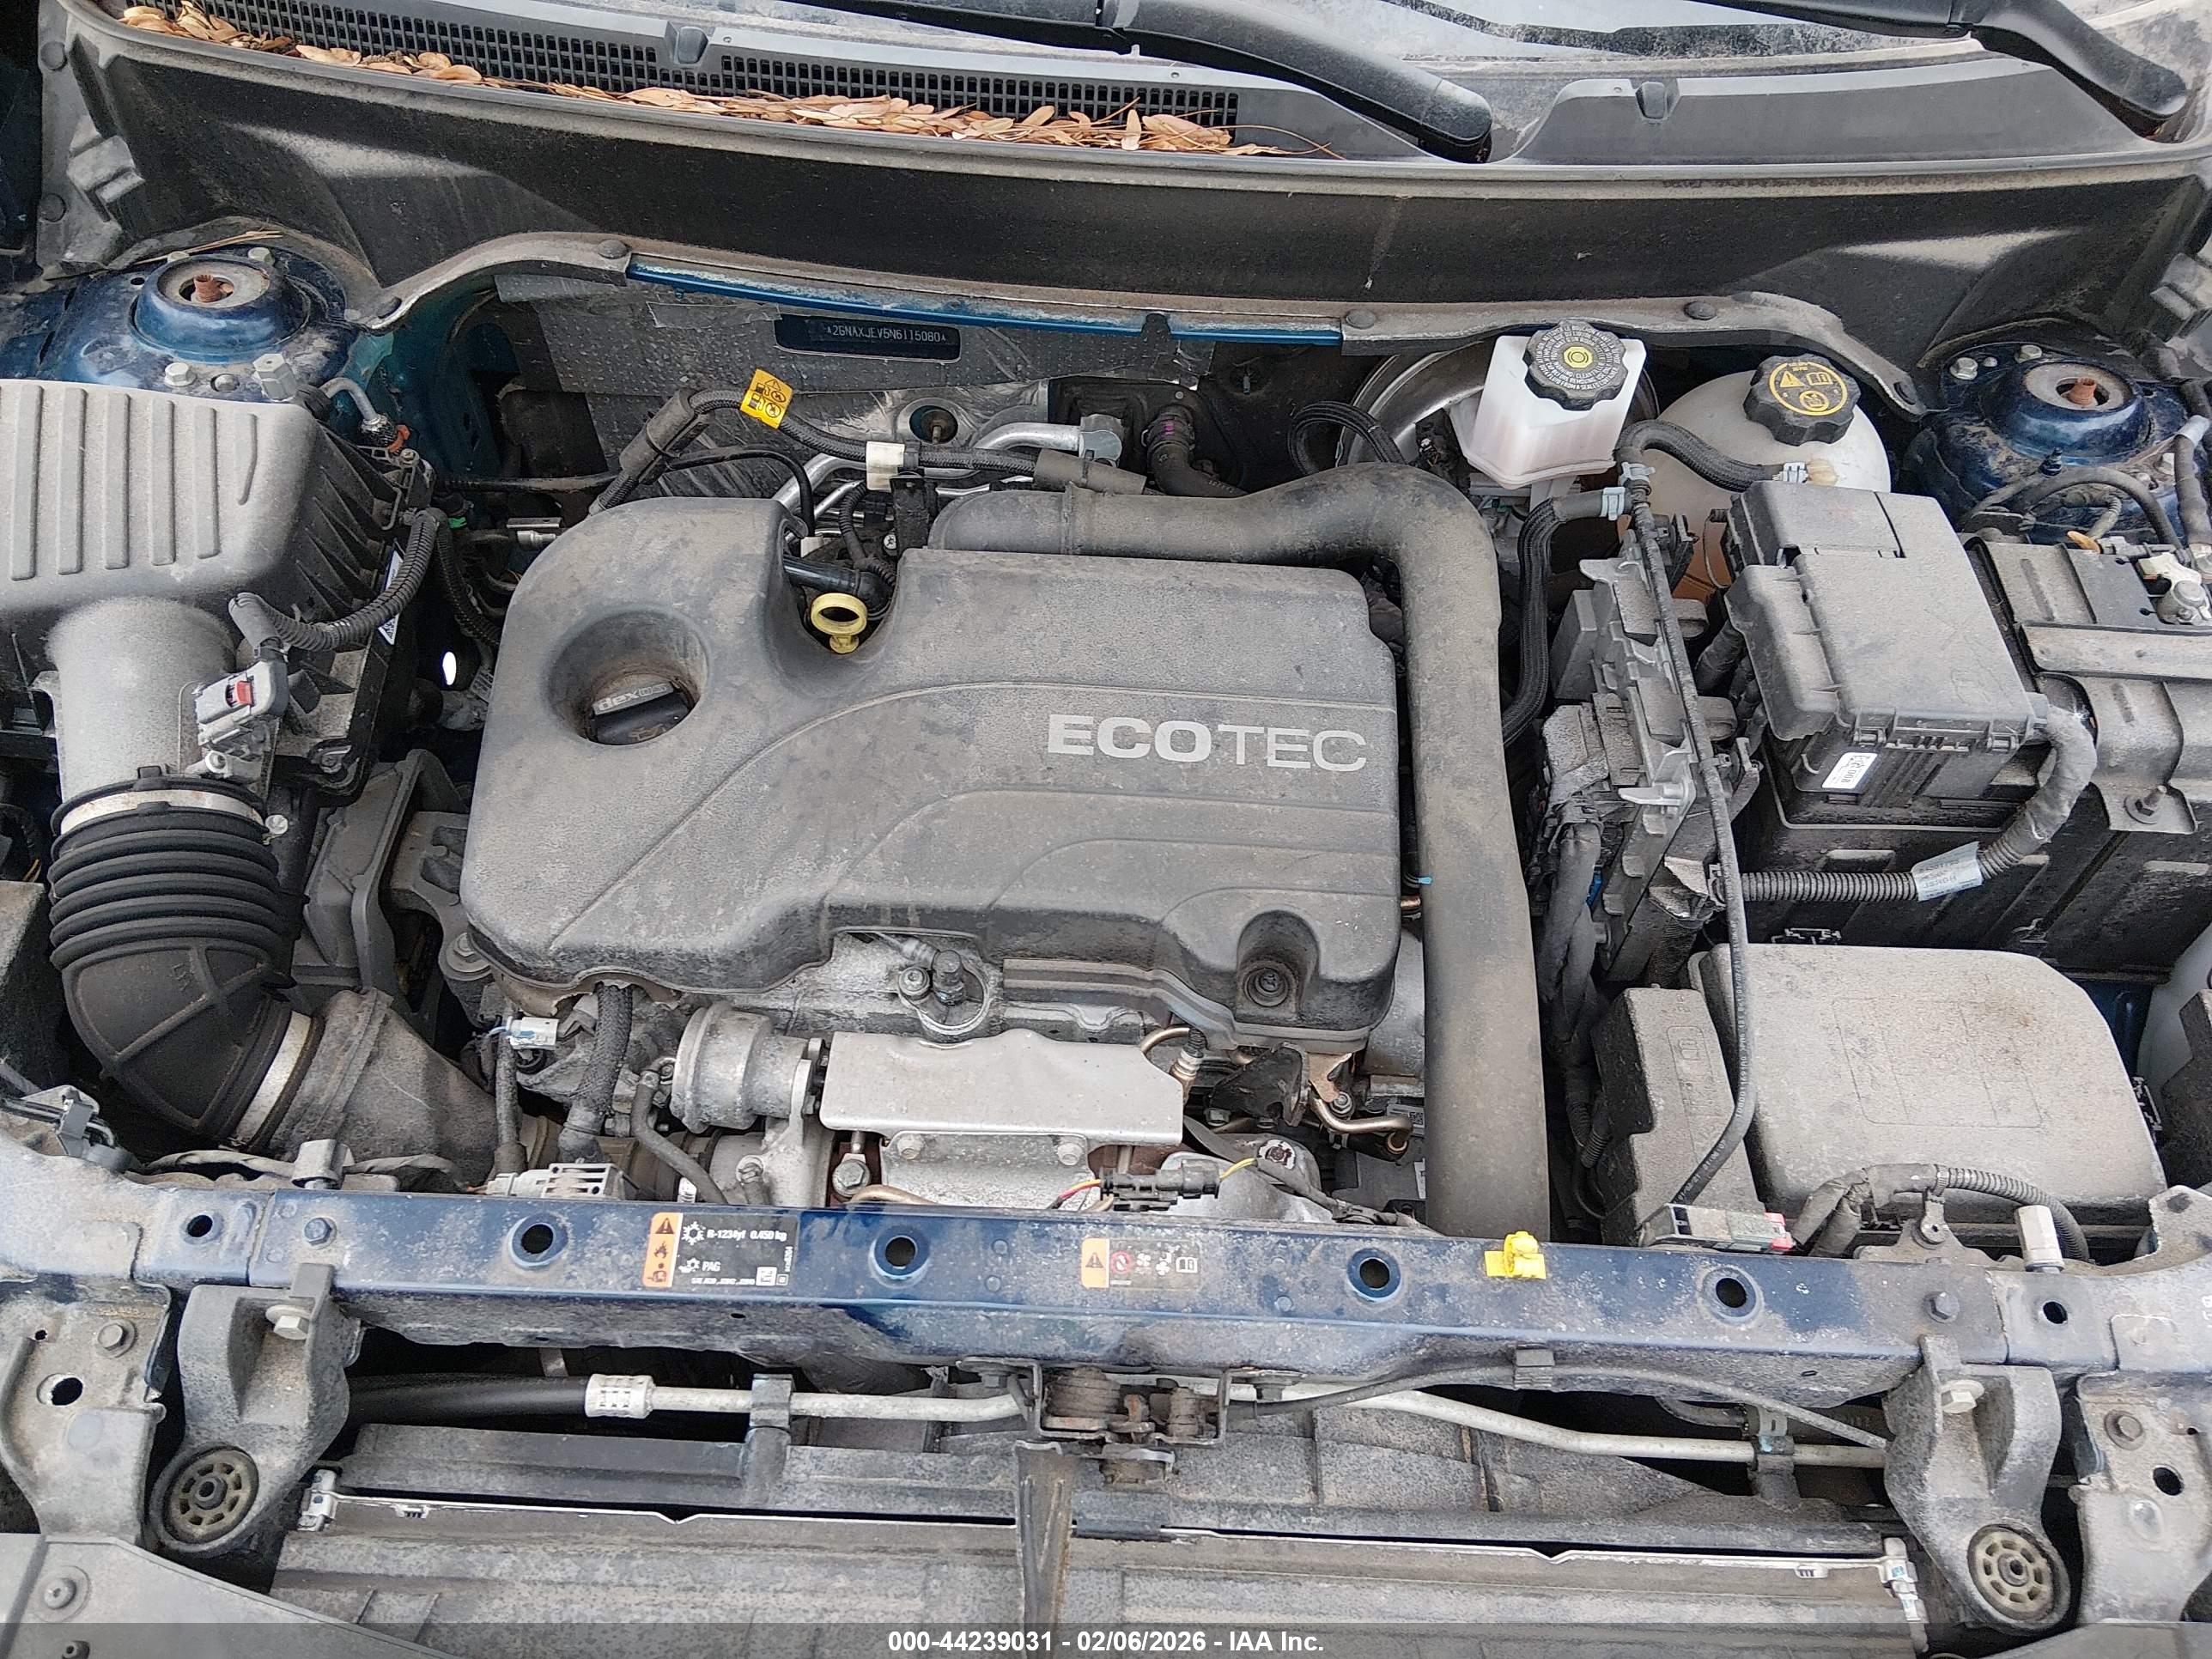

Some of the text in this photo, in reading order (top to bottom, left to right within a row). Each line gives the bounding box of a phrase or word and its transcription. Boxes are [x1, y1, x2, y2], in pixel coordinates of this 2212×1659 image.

[599, 684, 667, 711] dexos
[1048, 714, 1366, 772] ECOTEC
[707, 1230, 746, 1241] R-1234yf
[775, 1231, 787, 1242] kg
[702, 1261, 721, 1272] PAG
